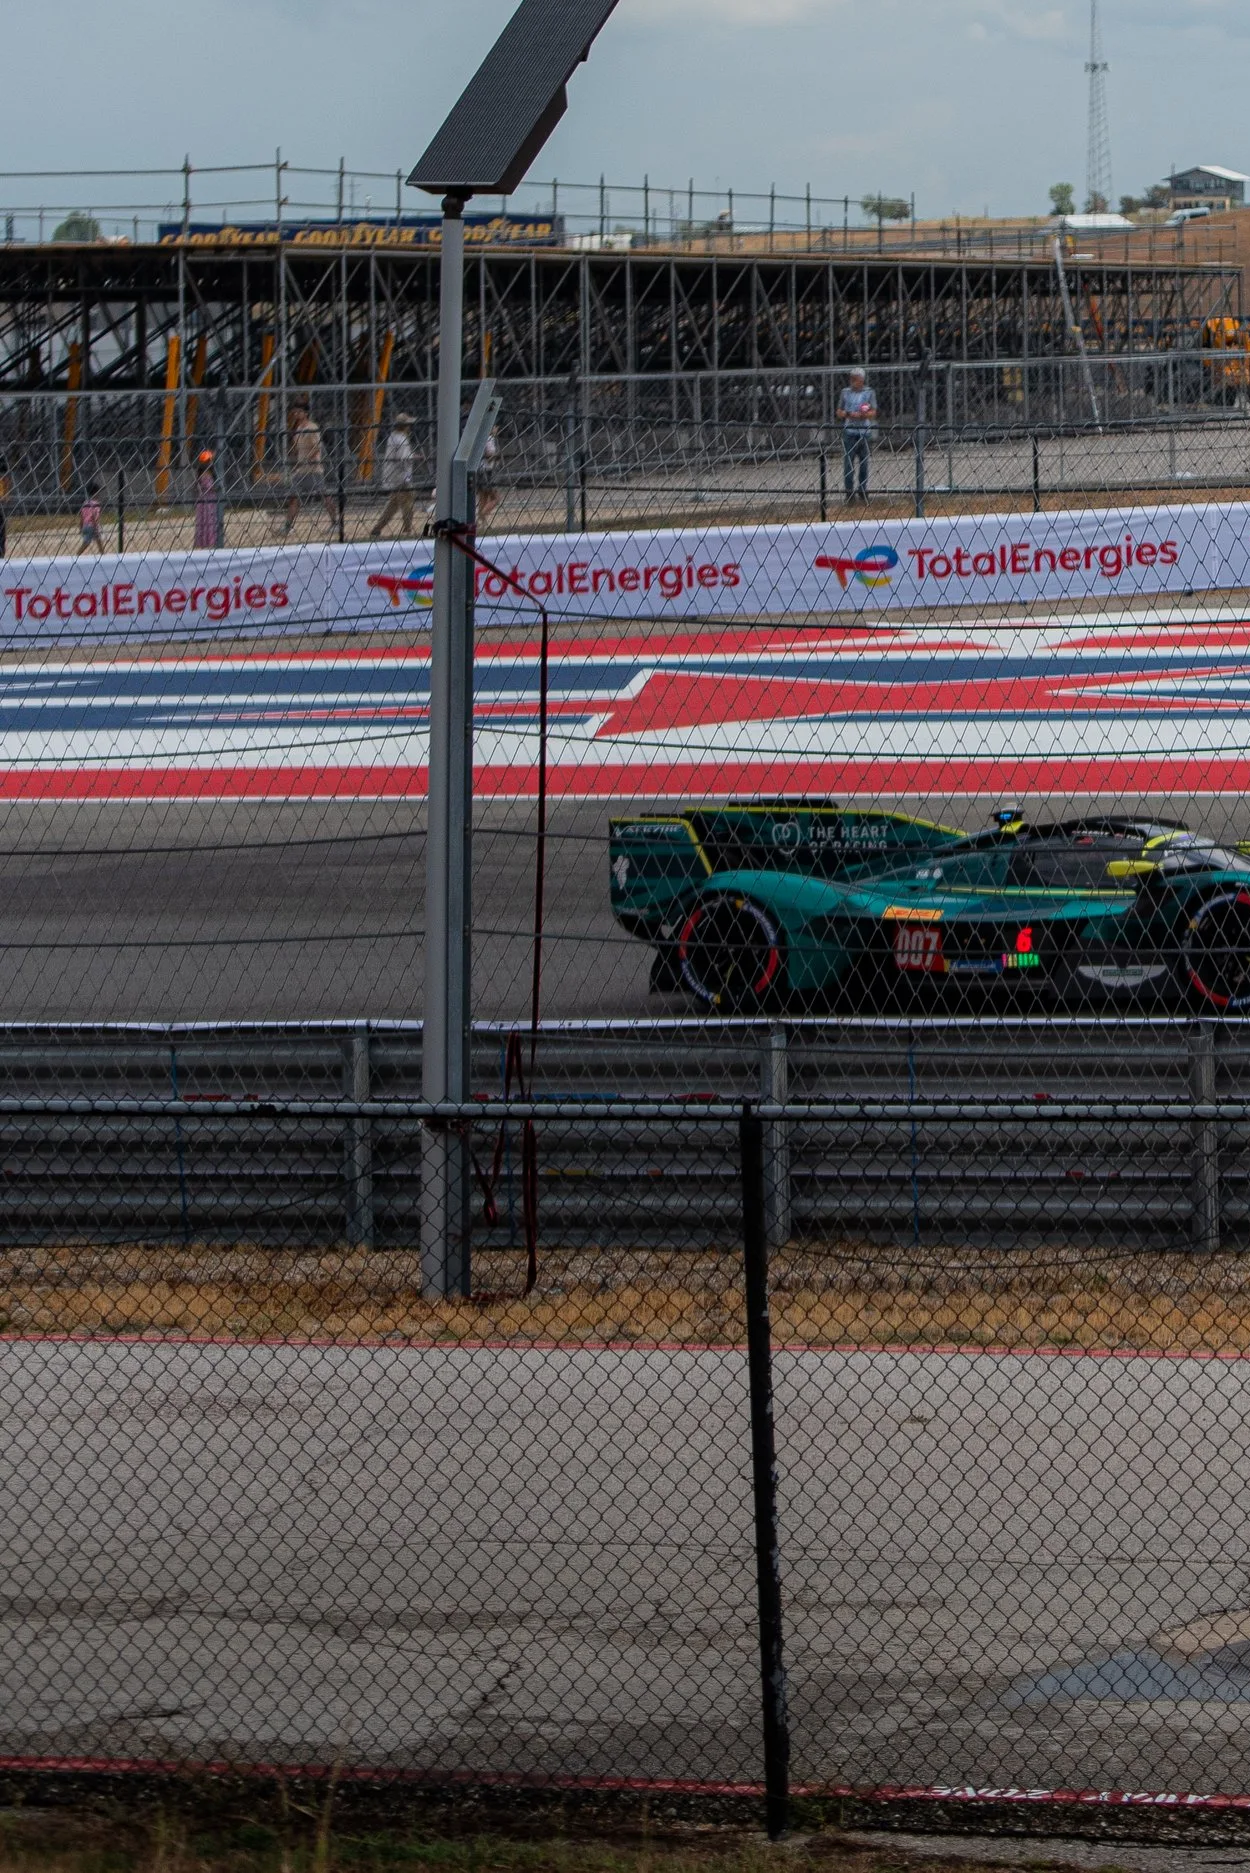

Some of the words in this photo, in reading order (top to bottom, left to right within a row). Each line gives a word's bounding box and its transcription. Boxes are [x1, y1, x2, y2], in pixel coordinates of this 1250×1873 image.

[428, 218, 552, 244] GODYEAR
[907, 534, 1179, 579] TotalEnergies
[4, 575, 290, 621] TotalEnergies
[808, 824, 836, 839] THE
[840, 824, 889, 839] HEART
[894, 928, 941, 969] 007
[1015, 927, 1033, 953] 6
